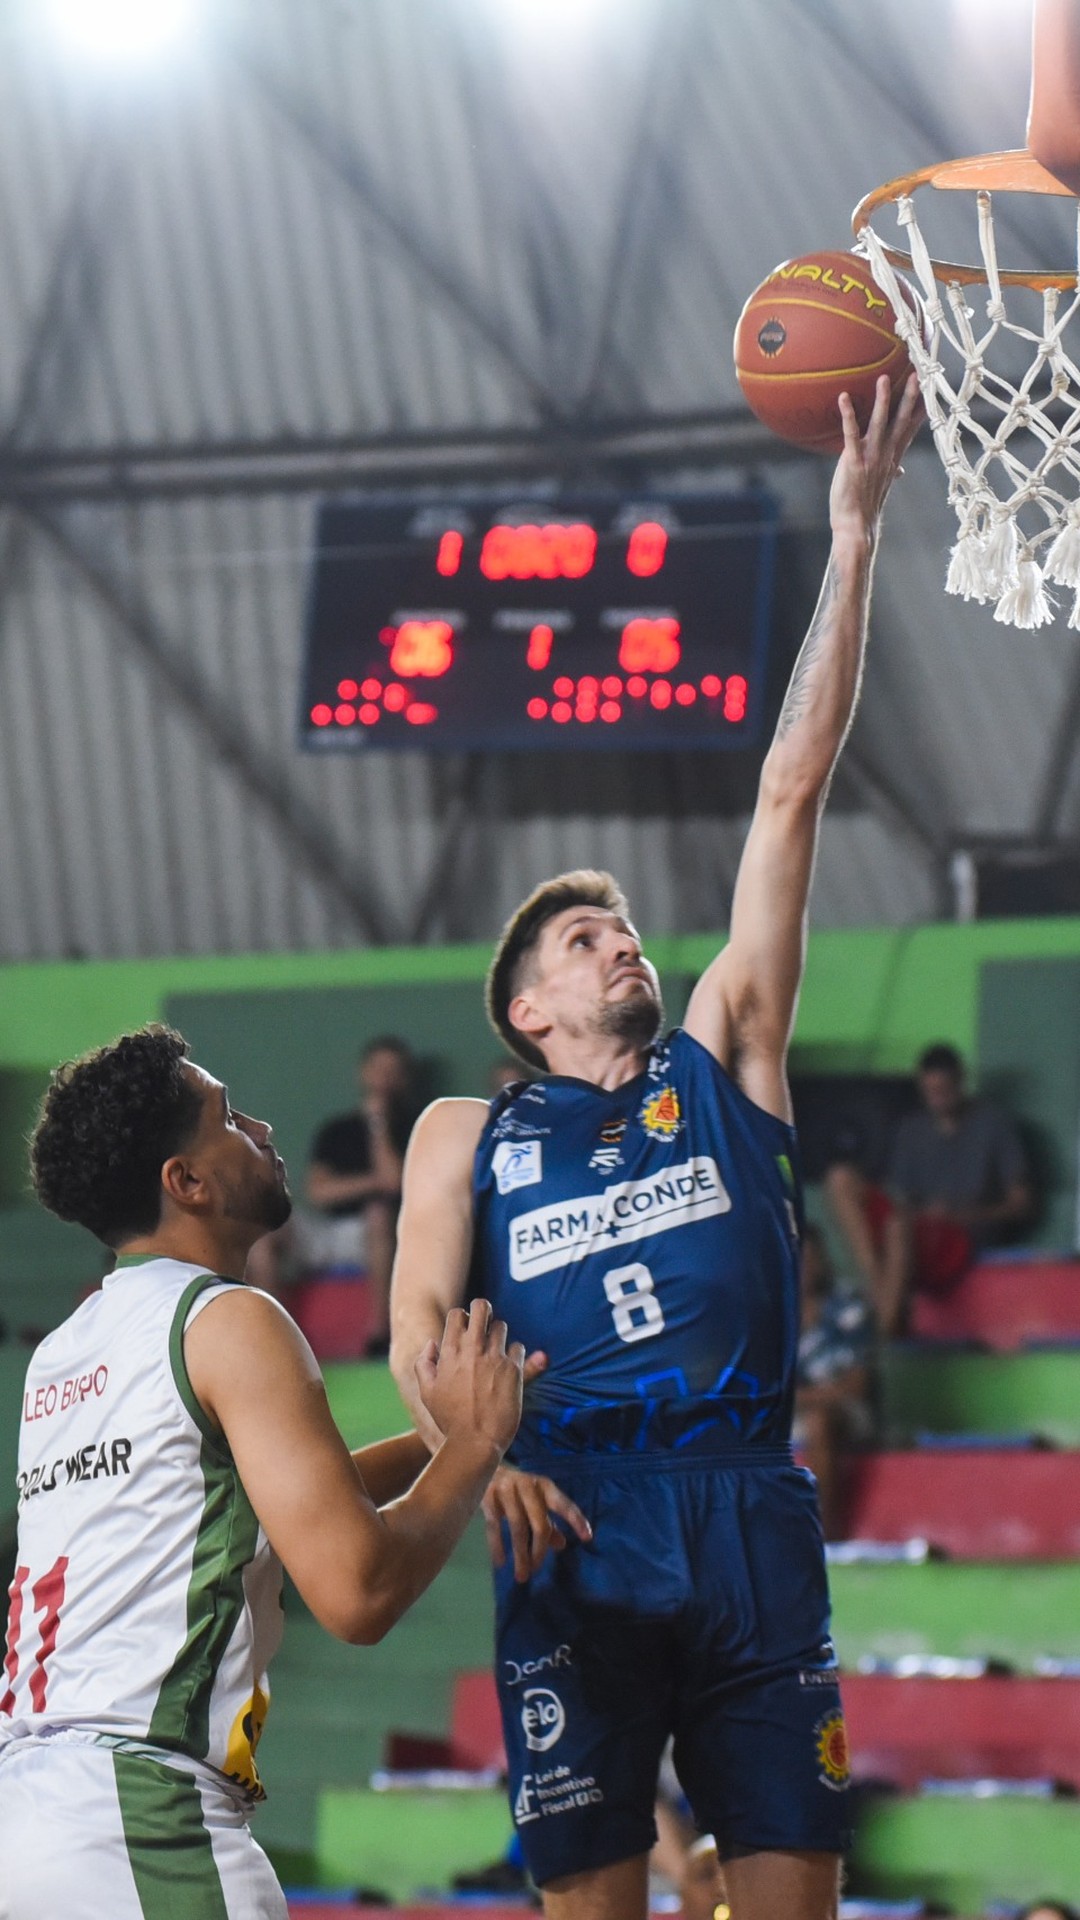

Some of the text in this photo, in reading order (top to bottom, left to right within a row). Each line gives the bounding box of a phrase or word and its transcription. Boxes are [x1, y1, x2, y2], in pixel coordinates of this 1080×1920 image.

[515, 1168, 715, 1254] FARMCONDE
[602, 1262, 665, 1343] 8
[24, 1384, 58, 1423] LEO
[65, 1437, 132, 1487] WEAR
[0, 1556, 69, 1718] 11
[536, 1776, 596, 1801] Incentivo
[541, 1795, 576, 1817] Fiscal
